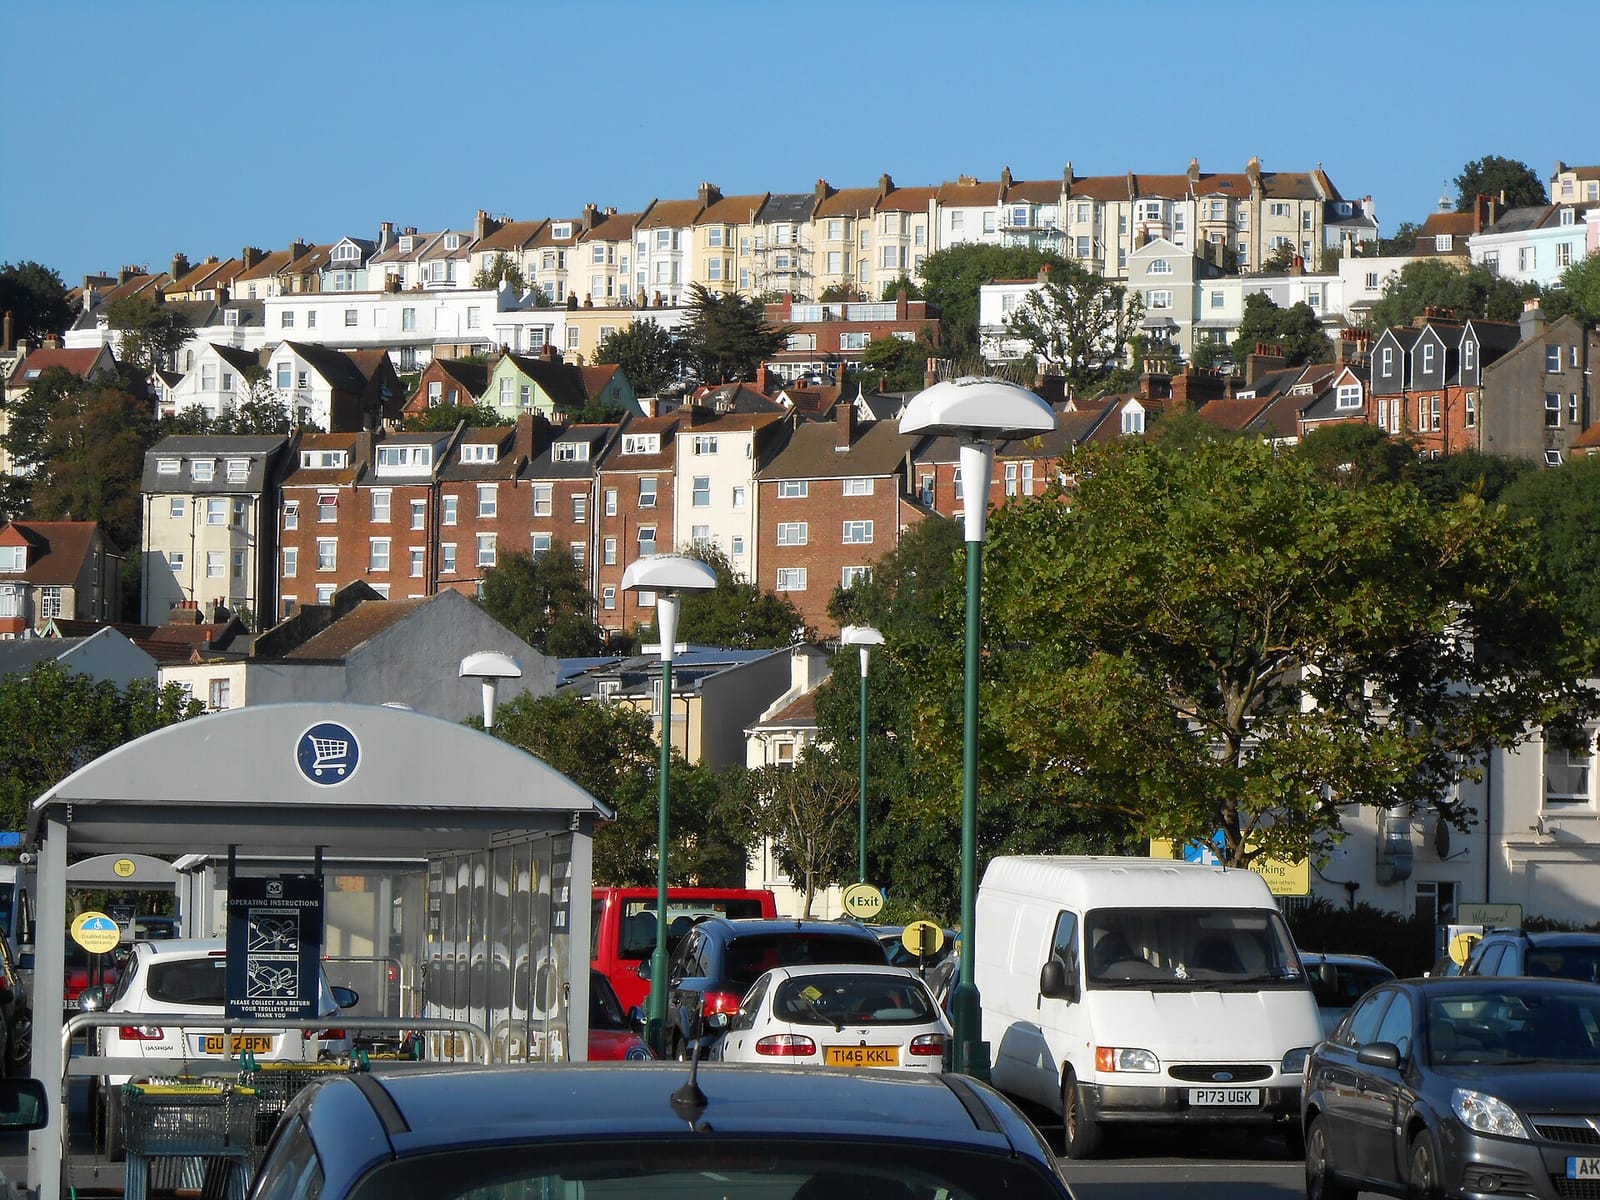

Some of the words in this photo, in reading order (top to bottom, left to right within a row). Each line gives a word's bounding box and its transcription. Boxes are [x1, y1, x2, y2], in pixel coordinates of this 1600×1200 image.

[857, 896, 879, 906] Exit
[206, 1037, 241, 1050] GU2
[245, 1037, 271, 1050] BFN
[833, 1050, 863, 1062] T146
[866, 1050, 894, 1062] KKL
[1196, 1091, 1225, 1103] P173
[1228, 1091, 1252, 1103] UGK
